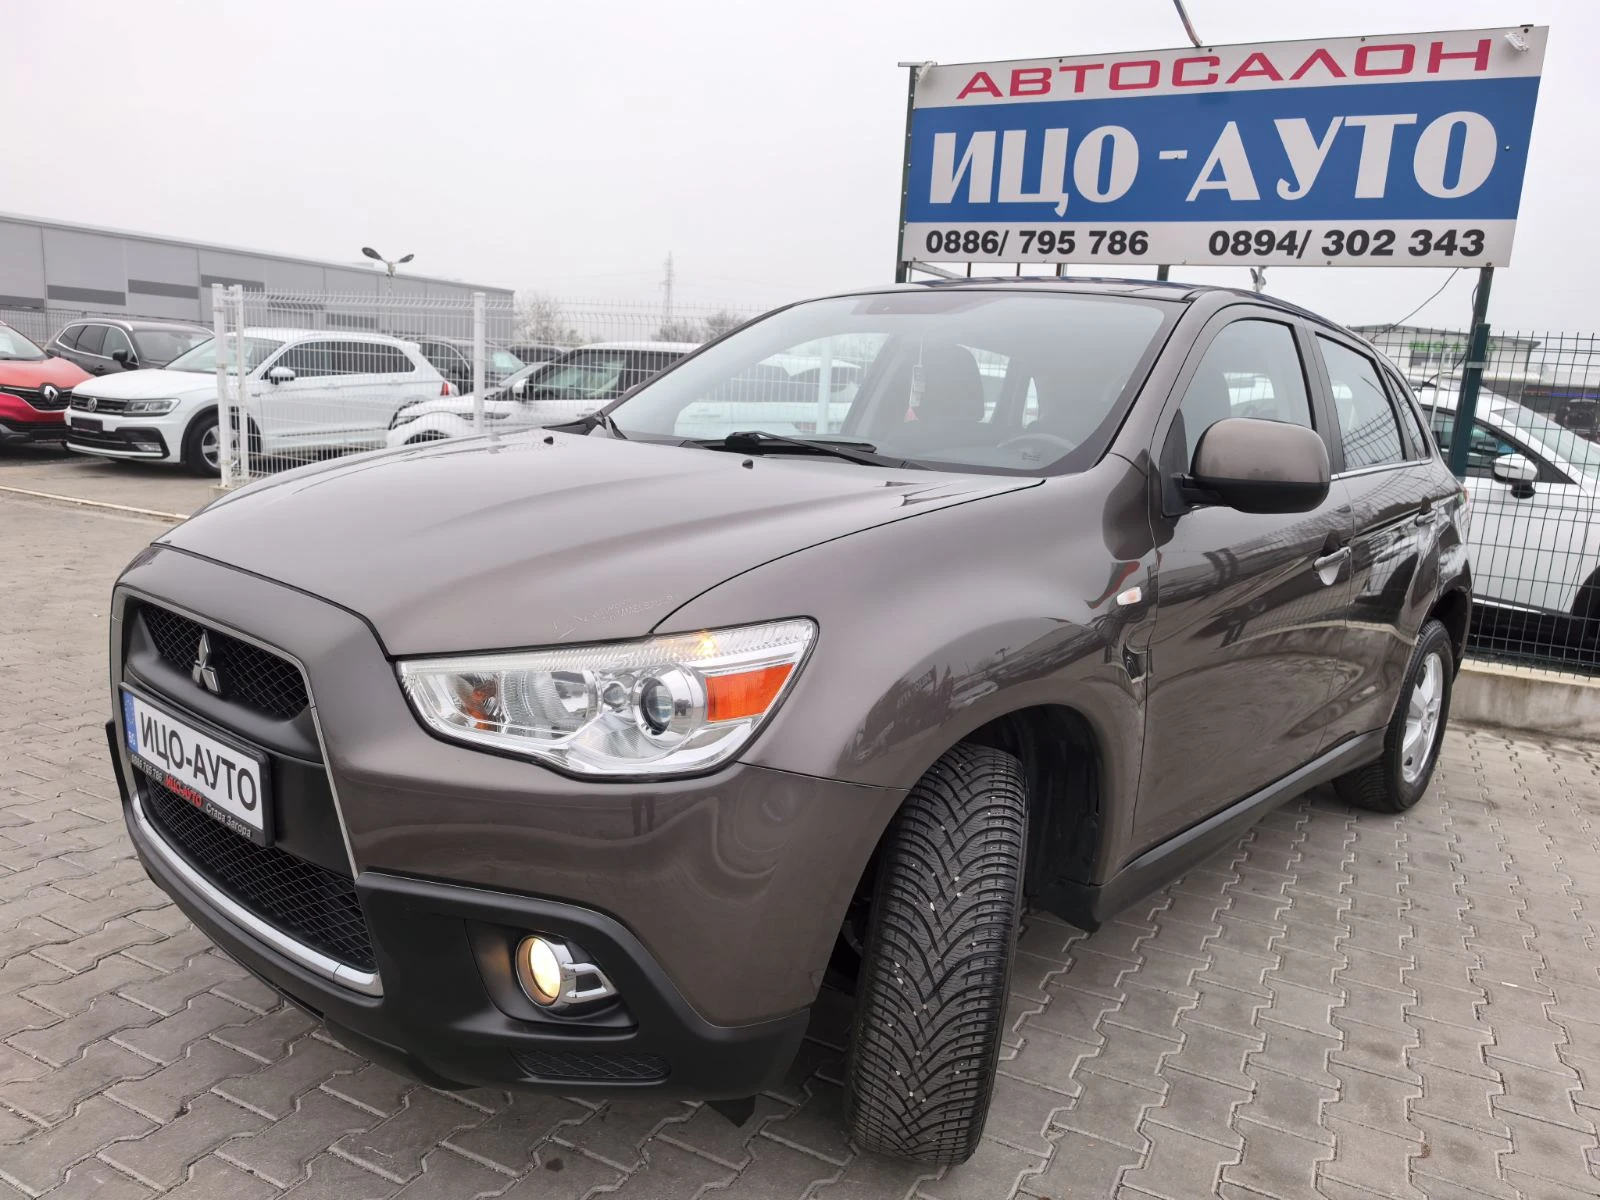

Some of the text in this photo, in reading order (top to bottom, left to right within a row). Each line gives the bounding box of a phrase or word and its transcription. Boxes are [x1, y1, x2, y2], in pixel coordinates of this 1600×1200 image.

[956, 38, 1492, 99] АВТОСАЛОН
[926, 230, 1149, 256] 0886/ 795 786
[1208, 229, 1485, 259] 0894/ 302 343
[140, 711, 257, 812] ИЦО-АУТО
[206, 802, 226, 823] Стара
[226, 815, 251, 838] Загора
